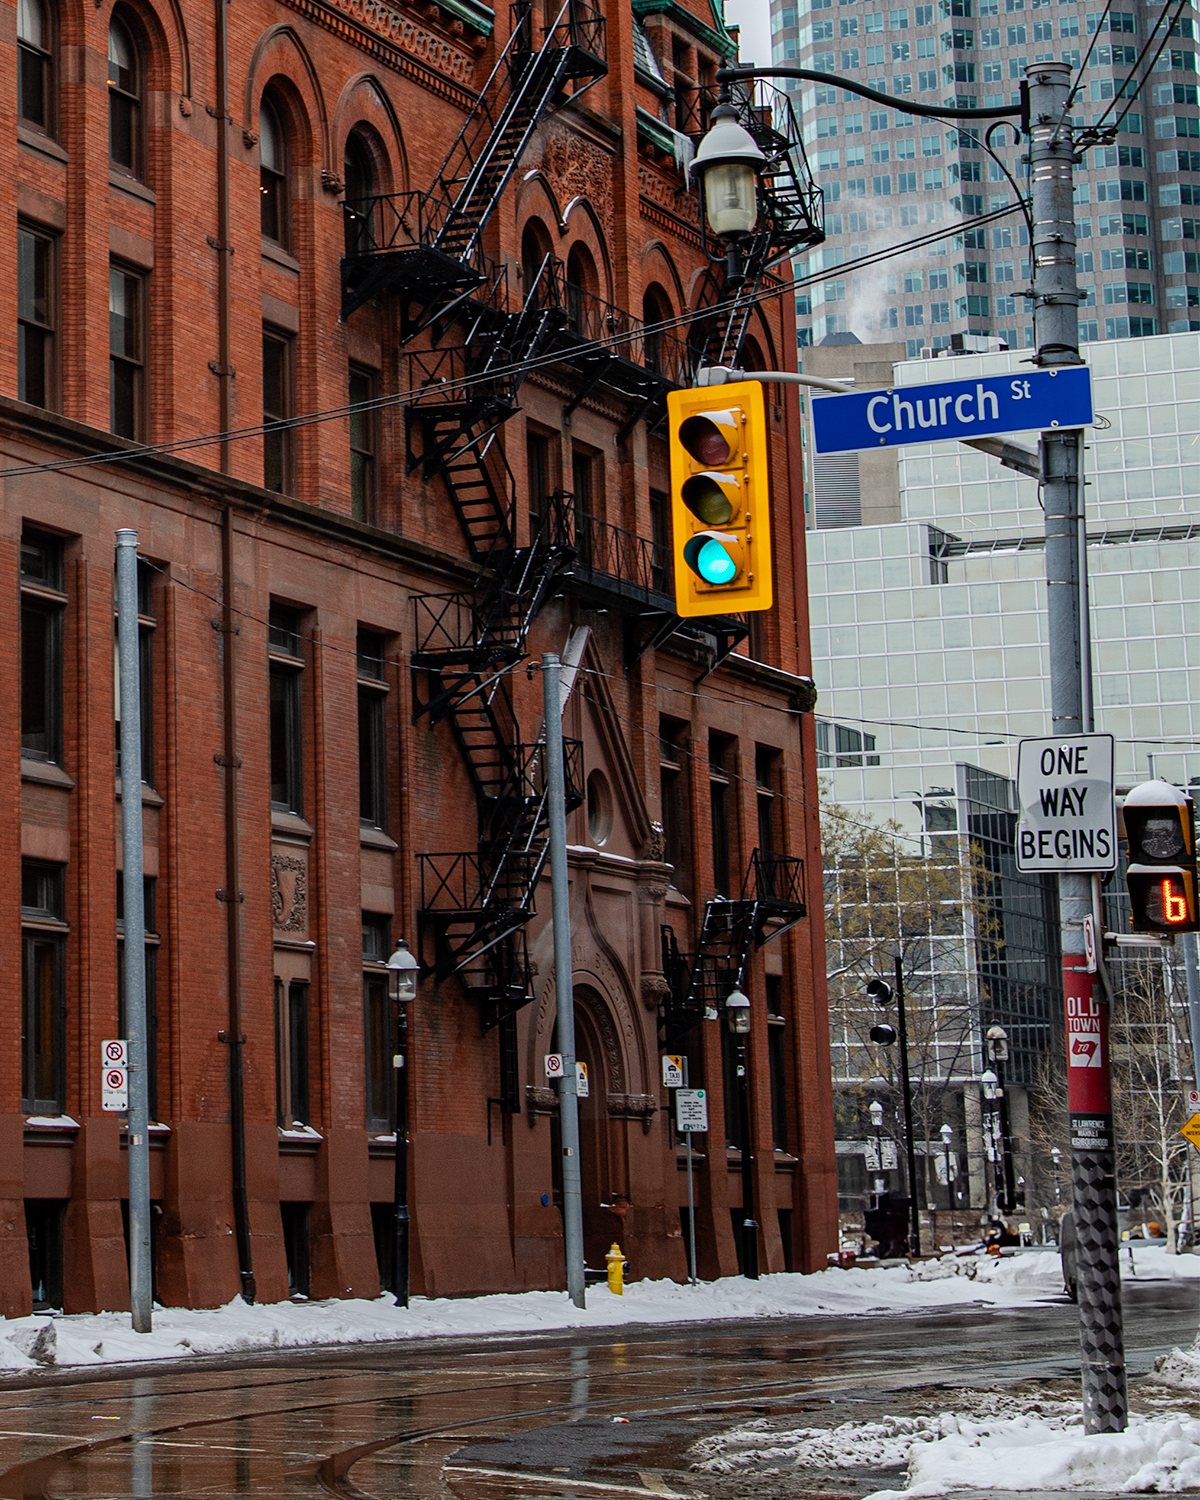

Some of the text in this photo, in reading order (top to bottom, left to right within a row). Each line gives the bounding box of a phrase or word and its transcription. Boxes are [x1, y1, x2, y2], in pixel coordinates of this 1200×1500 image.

[866, 380, 1031, 433] Church St
[1040, 746, 1088, 776] ONE
[1039, 787, 1088, 817] WAY
[1021, 828, 1110, 860] BEGINS
[1067, 997, 1099, 1016] OLD
[1068, 1018, 1100, 1032] TOWN
[1077, 1043, 1090, 1053] TO
[1078, 1119, 1106, 1129] LAWRENCE
[1071, 1137, 1109, 1147] EIGHBOURHOOD
